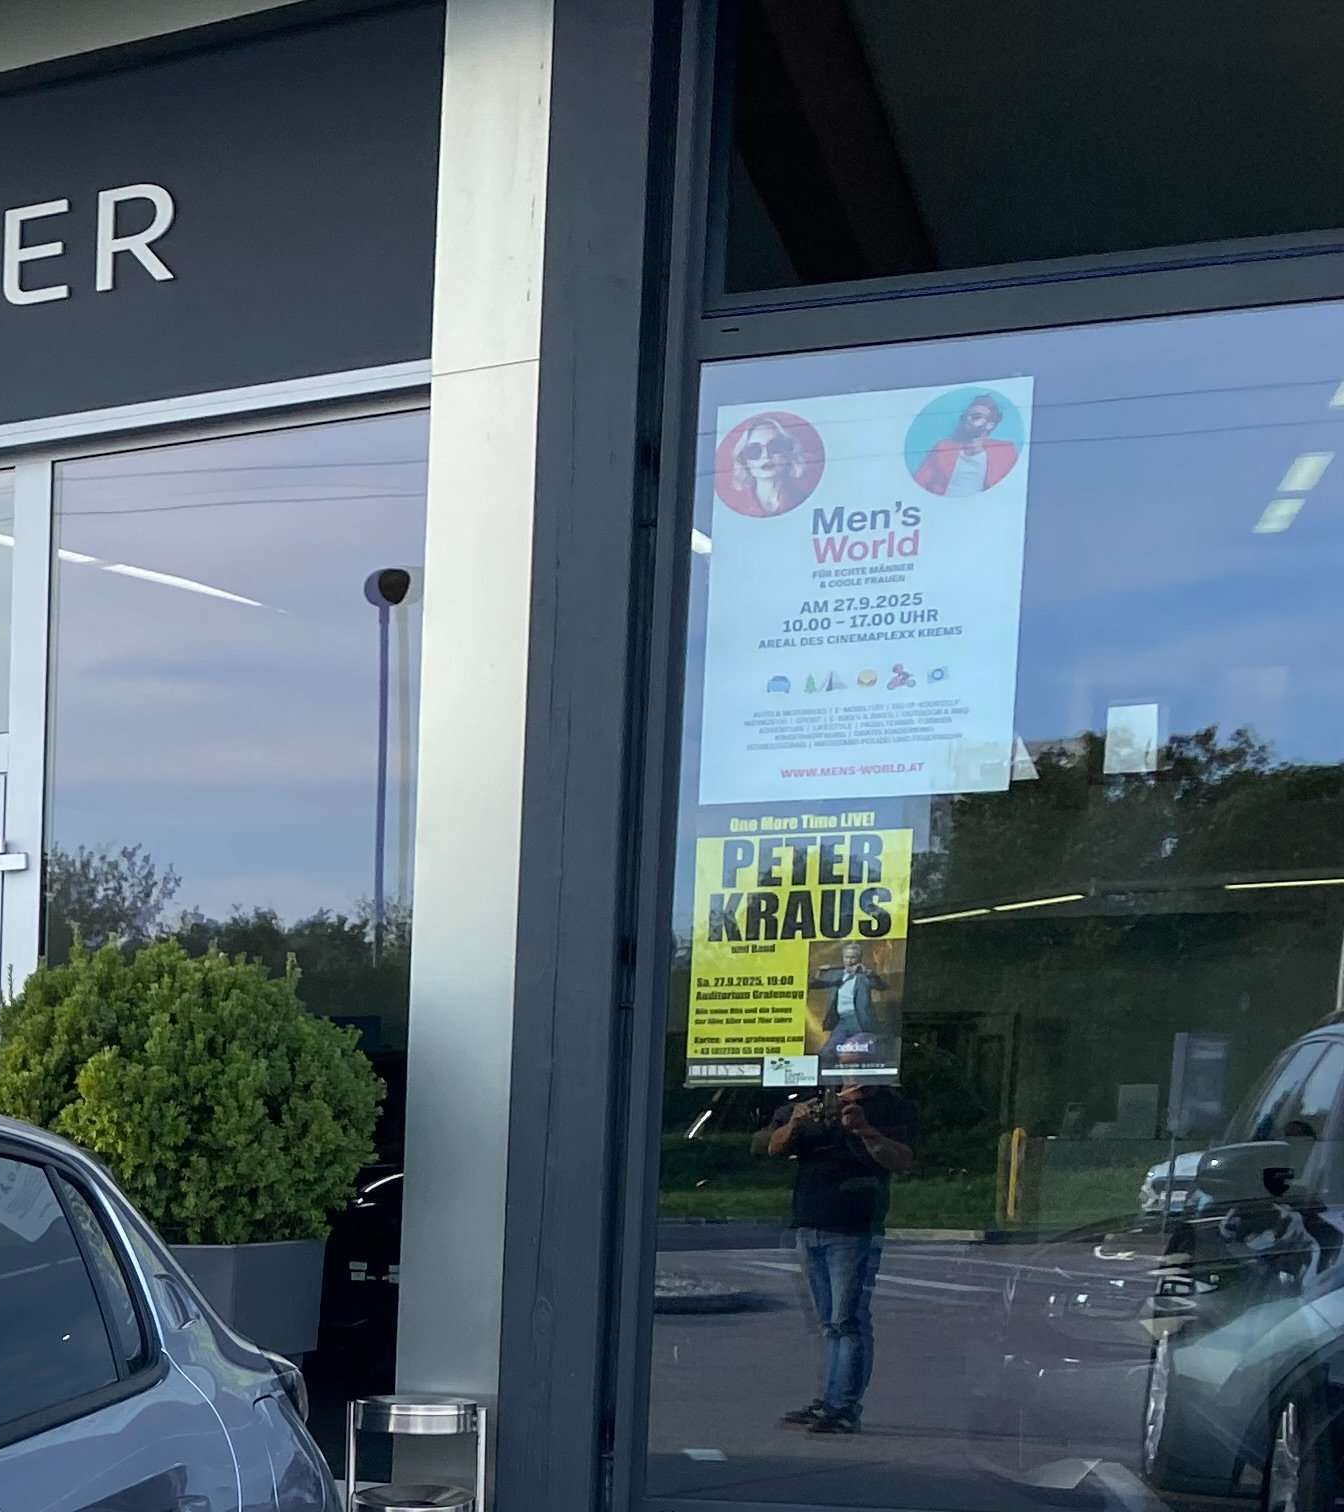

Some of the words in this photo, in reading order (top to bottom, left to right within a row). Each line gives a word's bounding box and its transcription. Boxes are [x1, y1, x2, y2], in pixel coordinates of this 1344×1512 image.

[812, 501, 921, 535] Men's
[813, 530, 920, 564] World
[864, 574, 905, 585] FRAUEN
[800, 601, 829, 614] AM
[833, 592, 923, 612] 27.9.2025
[782, 617, 831, 633] 10.00
[849, 612, 895, 628] 17.00
[900, 608, 939, 625] UHR
[758, 638, 796, 649] AREAL
[800, 635, 824, 646] DES
[827, 629, 915, 645] CINEMAPLEXX
[918, 626, 963, 638] KREMS
[780, 762, 924, 778] WWW.MENS-WORLD.AT
[730, 817, 757, 832] One
[761, 815, 798, 831] More
[801, 813, 837, 829] Time
[840, 812, 875, 828] LIVE!
[722, 834, 883, 888] PETER
[708, 887, 892, 942] KRAUS
[696, 990, 750, 1001] Auditorium
[752, 989, 804, 1001] Grafenegg
